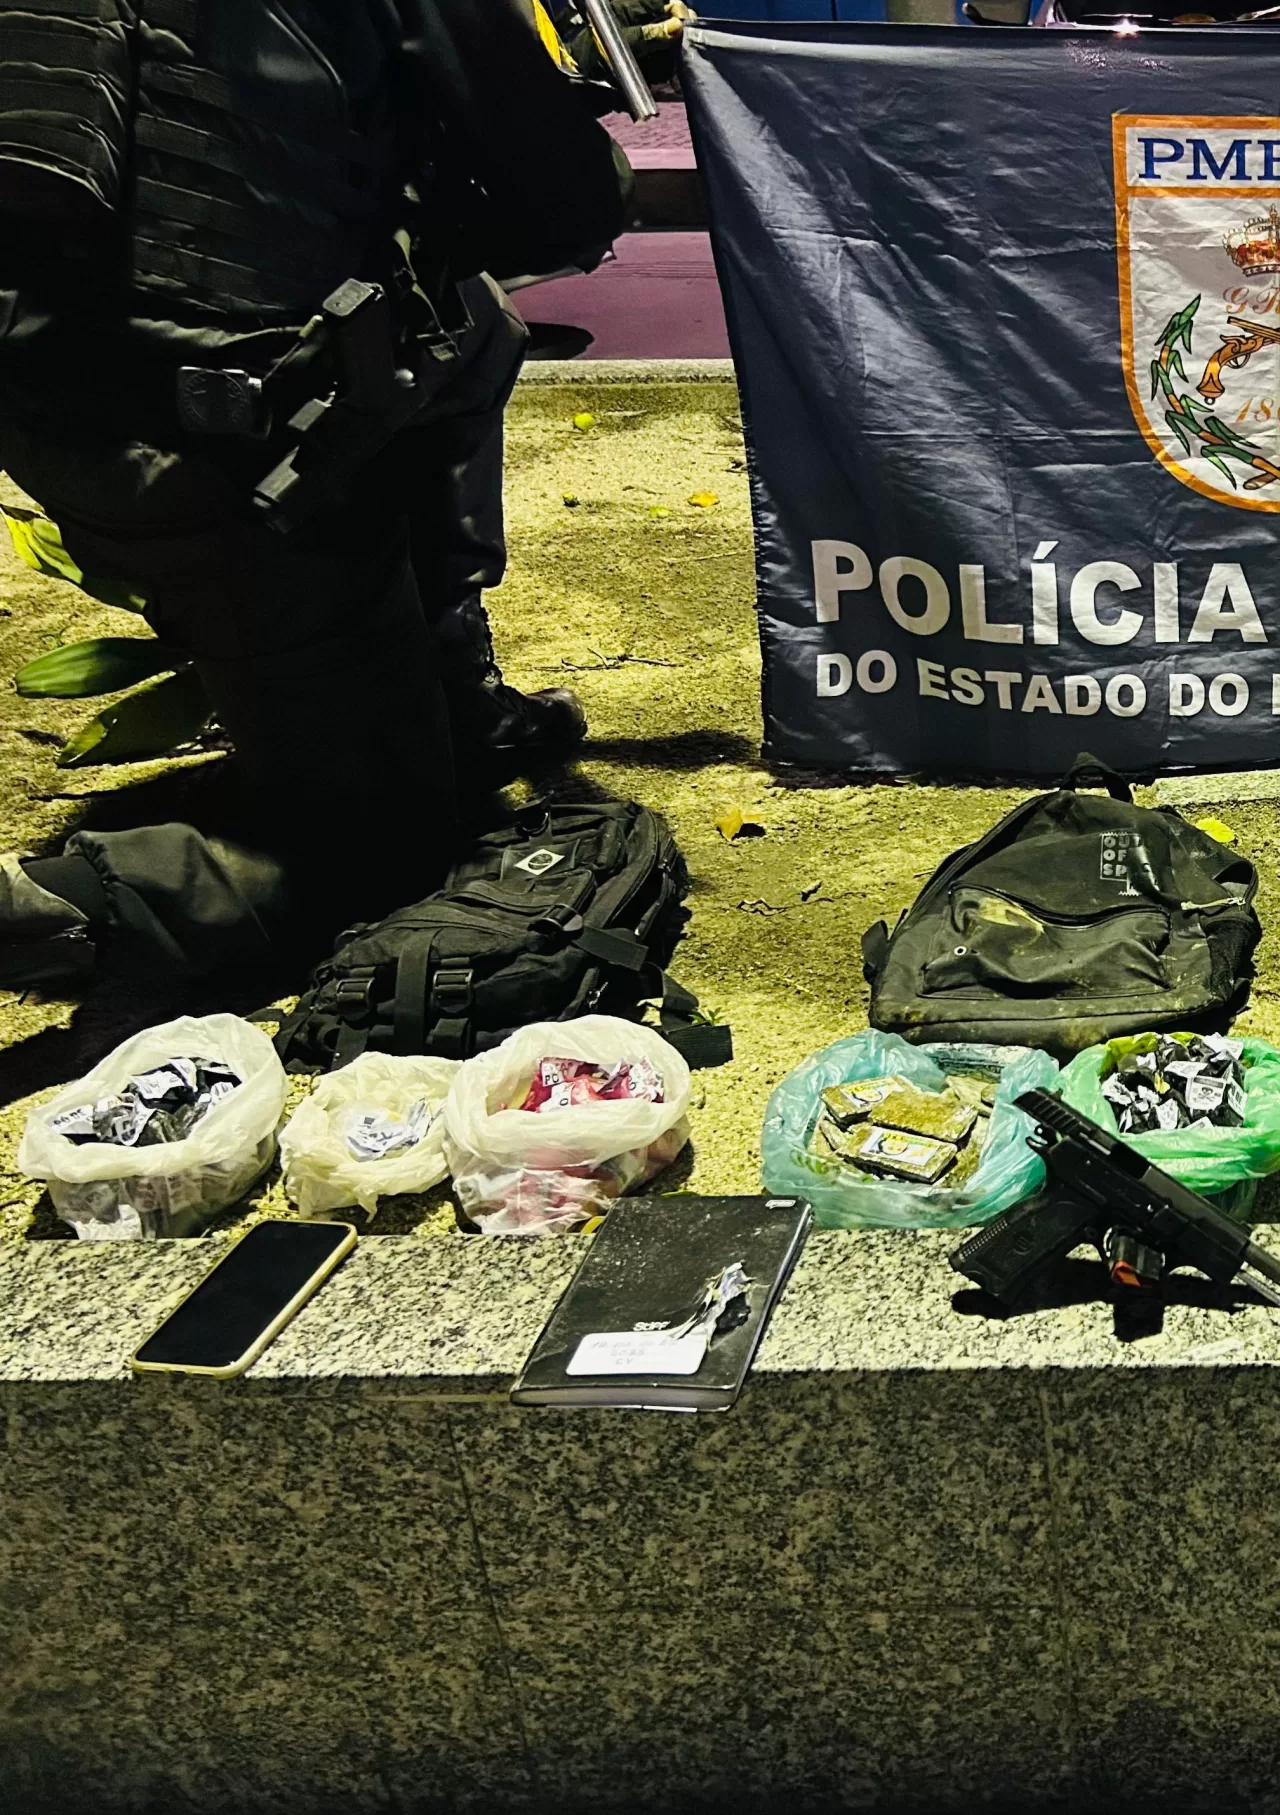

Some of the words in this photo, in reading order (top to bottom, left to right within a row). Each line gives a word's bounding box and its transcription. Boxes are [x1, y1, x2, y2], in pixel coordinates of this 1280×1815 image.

[811, 539, 1268, 646] POLÍCIA
[816, 650, 897, 698] DO
[917, 658, 1147, 717] ESTADO
[1168, 673, 1249, 717] DO
[1103, 849, 1127, 862] OF
